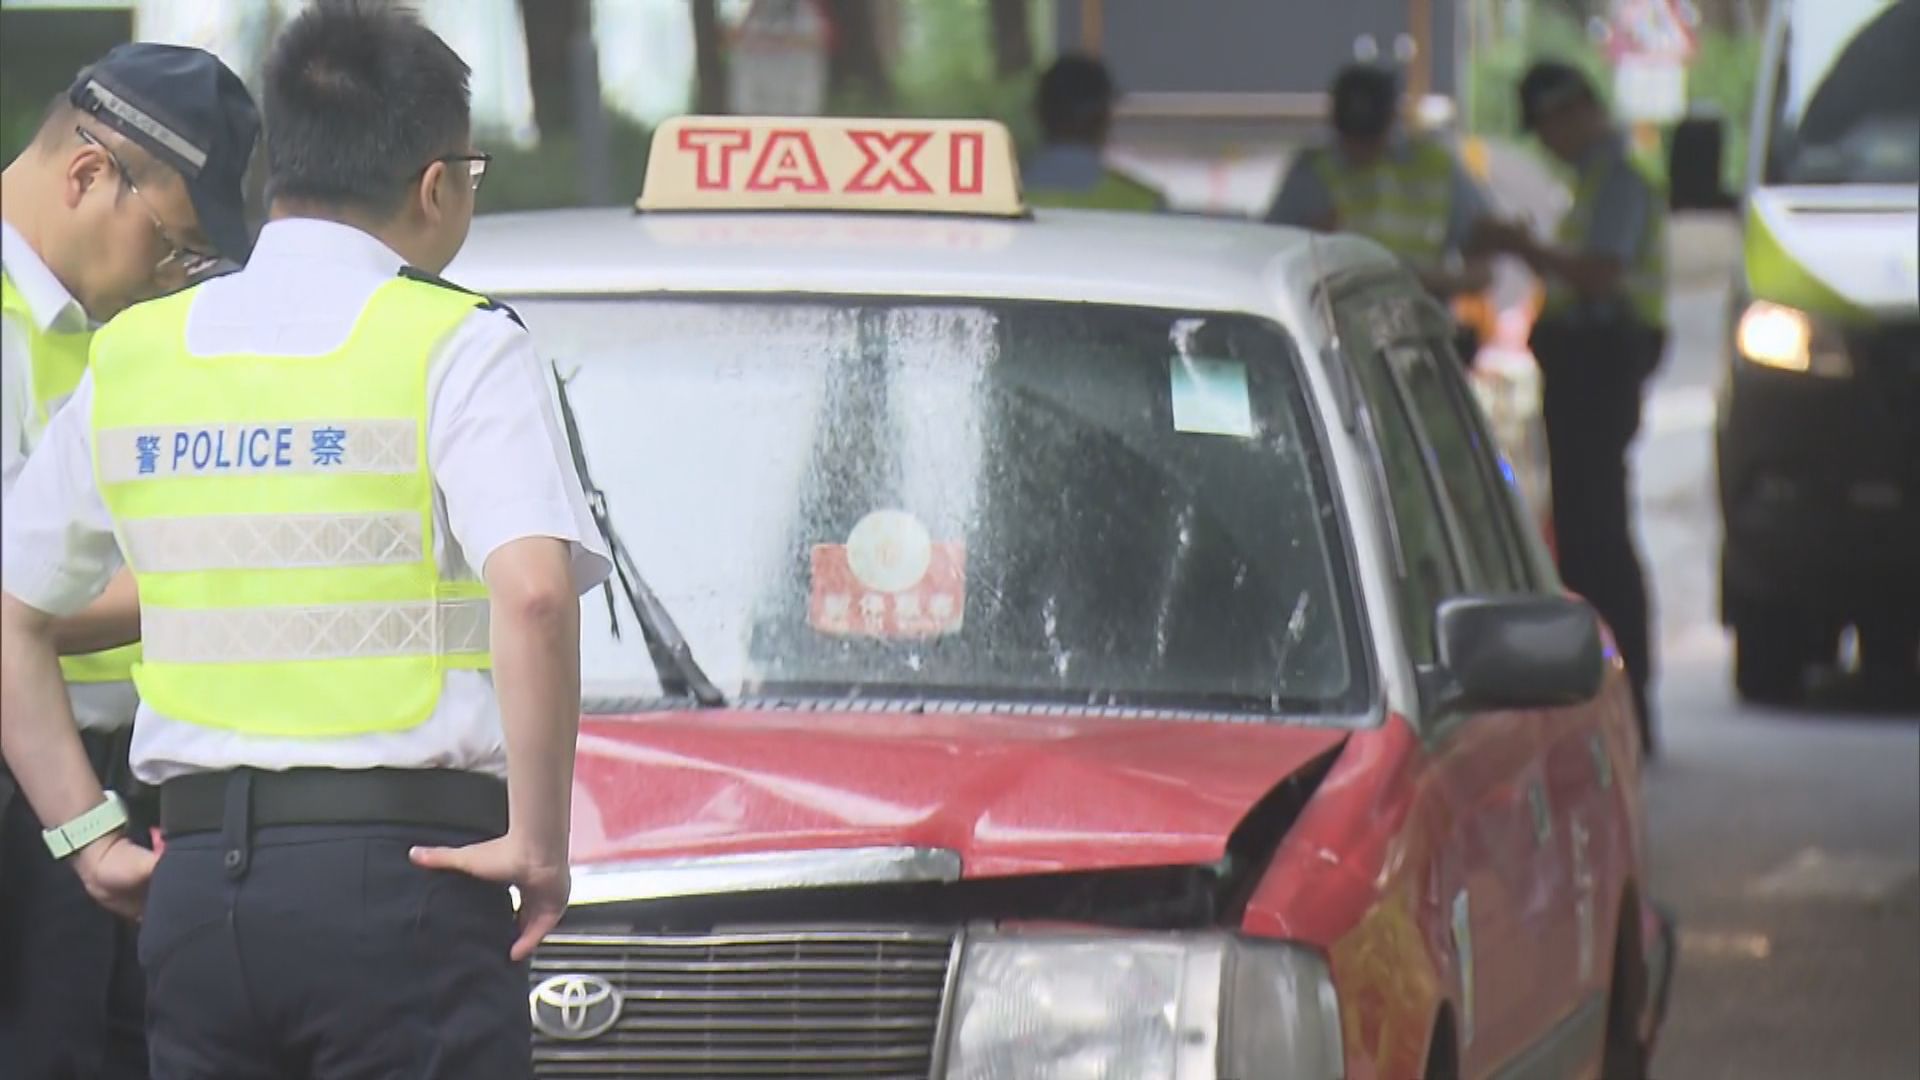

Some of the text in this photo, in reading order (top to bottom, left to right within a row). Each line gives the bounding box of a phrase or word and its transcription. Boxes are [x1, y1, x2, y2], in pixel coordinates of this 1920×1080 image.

[678, 128, 984, 195] TAXI
[135, 426, 346, 475] 警 POLICE 察
